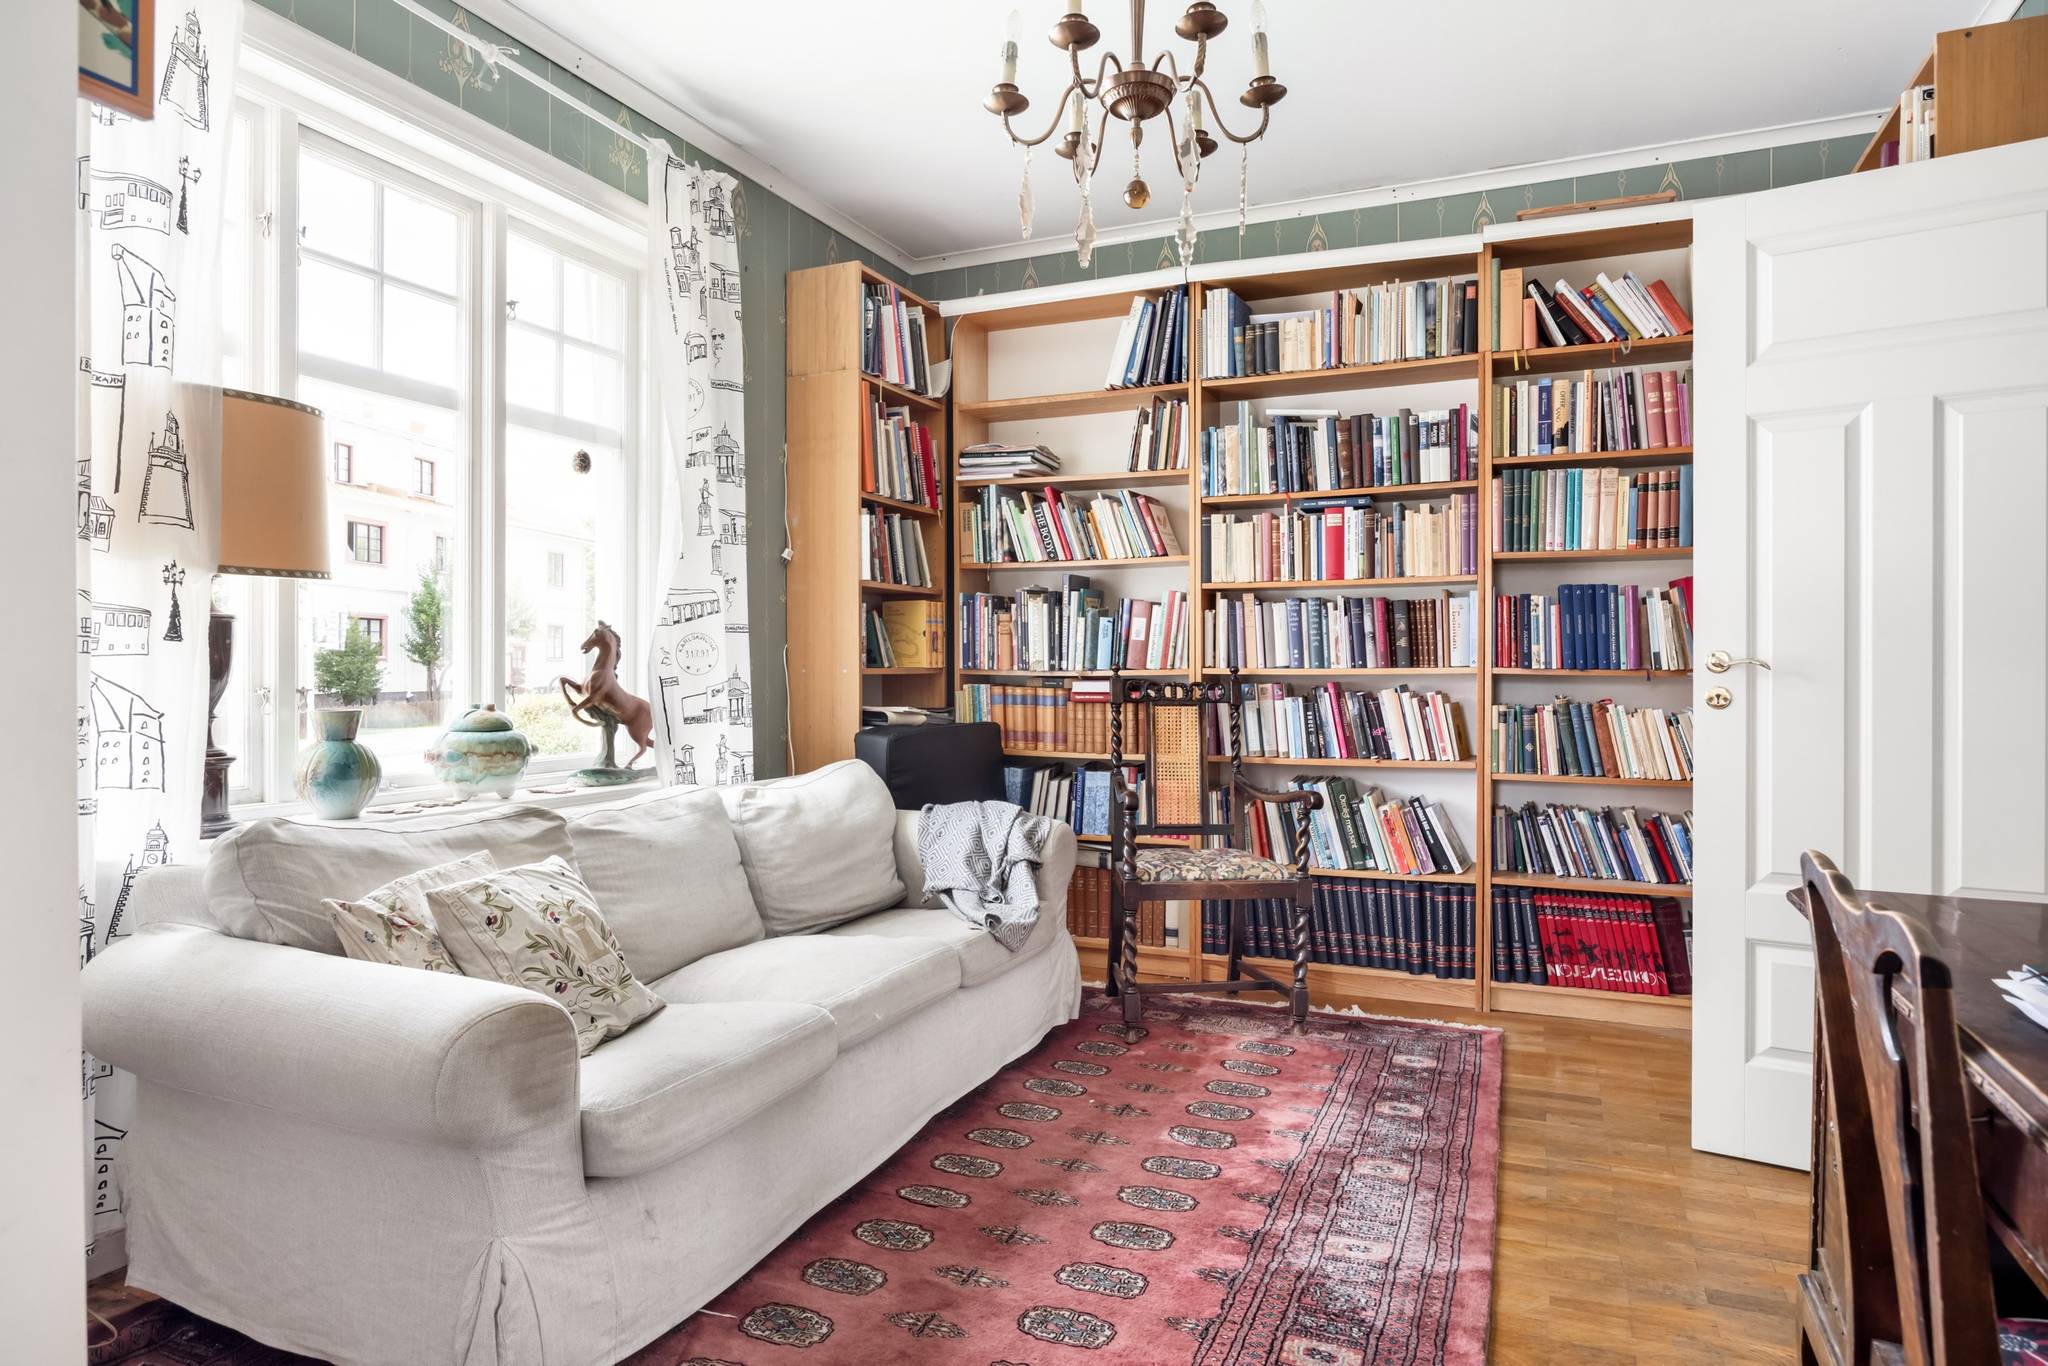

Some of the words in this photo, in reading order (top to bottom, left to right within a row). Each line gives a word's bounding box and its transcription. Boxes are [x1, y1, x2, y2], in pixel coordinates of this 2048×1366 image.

[1034, 507, 1047, 527] THE
[1040, 527, 1055, 552] BODY
[1345, 818, 1354, 833] men
[1348, 832, 1358, 849] sant
